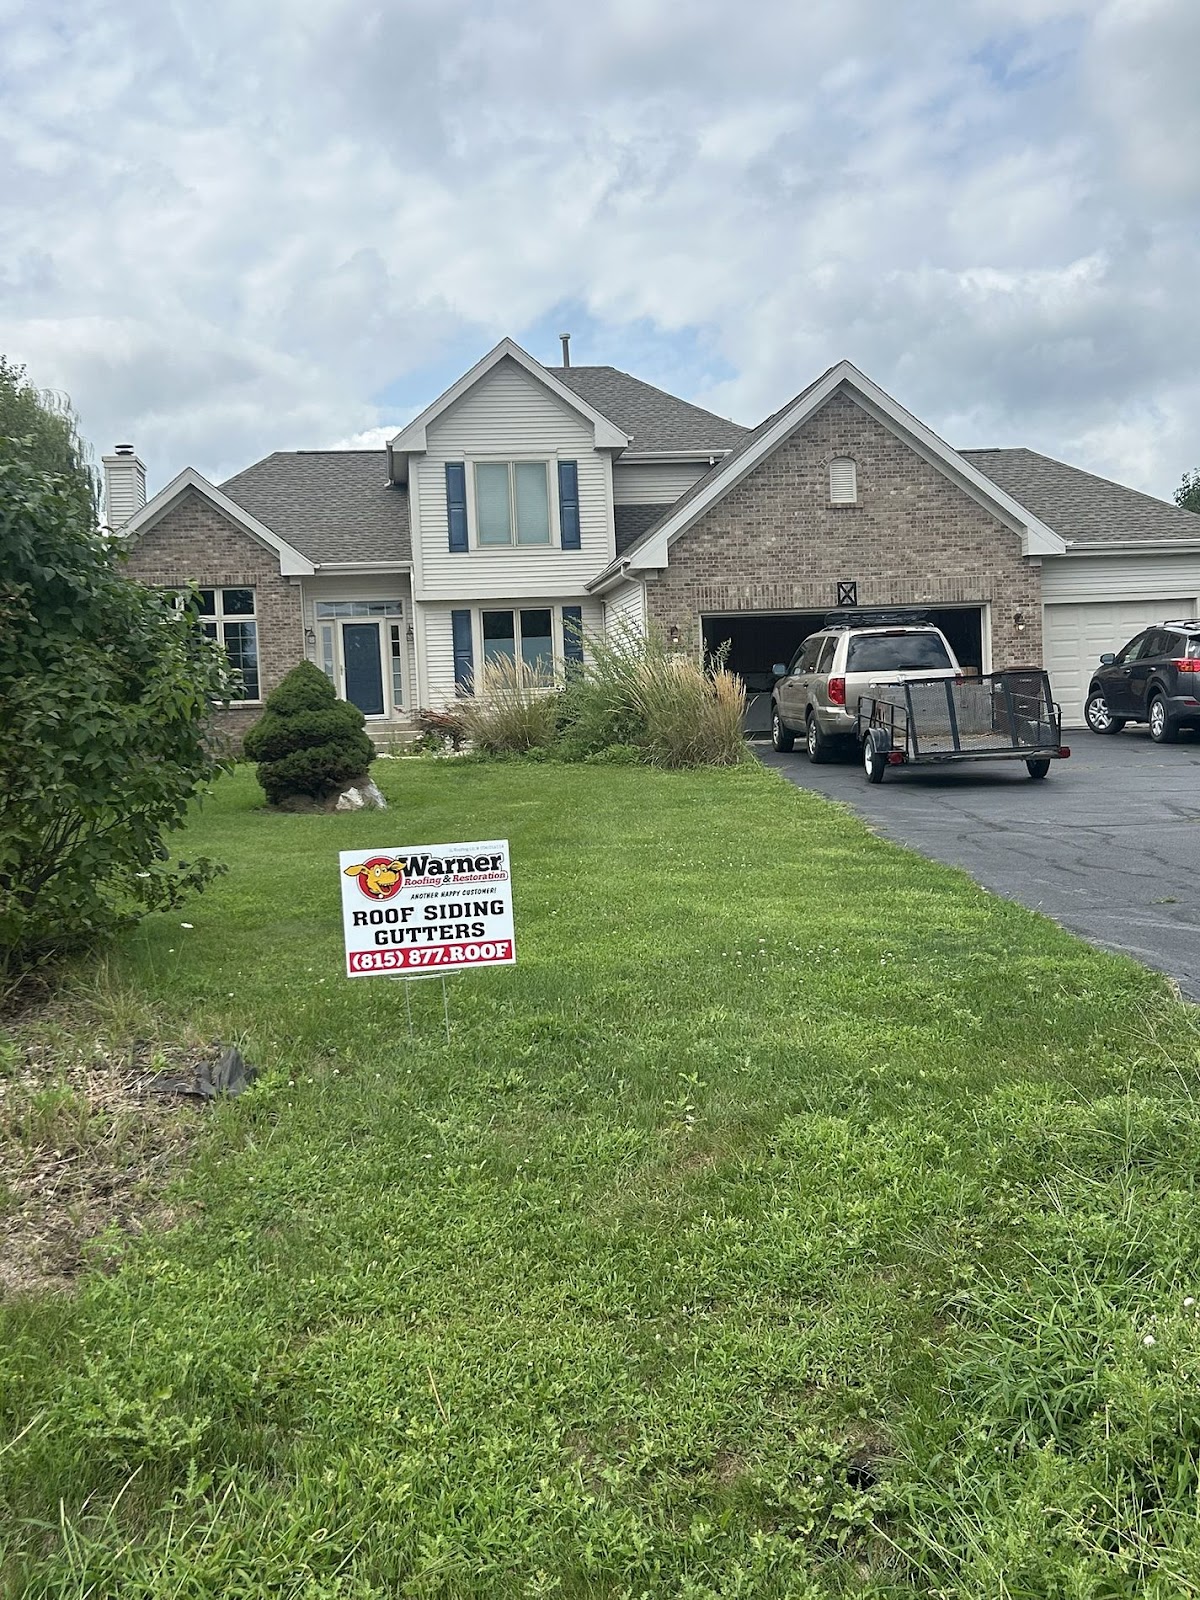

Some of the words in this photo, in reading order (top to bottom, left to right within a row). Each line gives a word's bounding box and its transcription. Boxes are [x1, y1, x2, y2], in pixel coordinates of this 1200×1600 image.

[399, 855, 502, 877] Warner
[405, 877, 441, 886] Roofing
[443, 874, 452, 882] &
[452, 872, 505, 882] Restoration
[411, 892, 438, 900] ANOTHER
[441, 890, 460, 898] HAPPY
[462, 888, 497, 896] CUSTOMER!
[353, 907, 414, 926] ROOF
[424, 900, 504, 921] SIDING
[375, 922, 485, 945] GUTTERS
[352, 952, 404, 970] (815)
[408, 942, 508, 965] 877.ROOF
